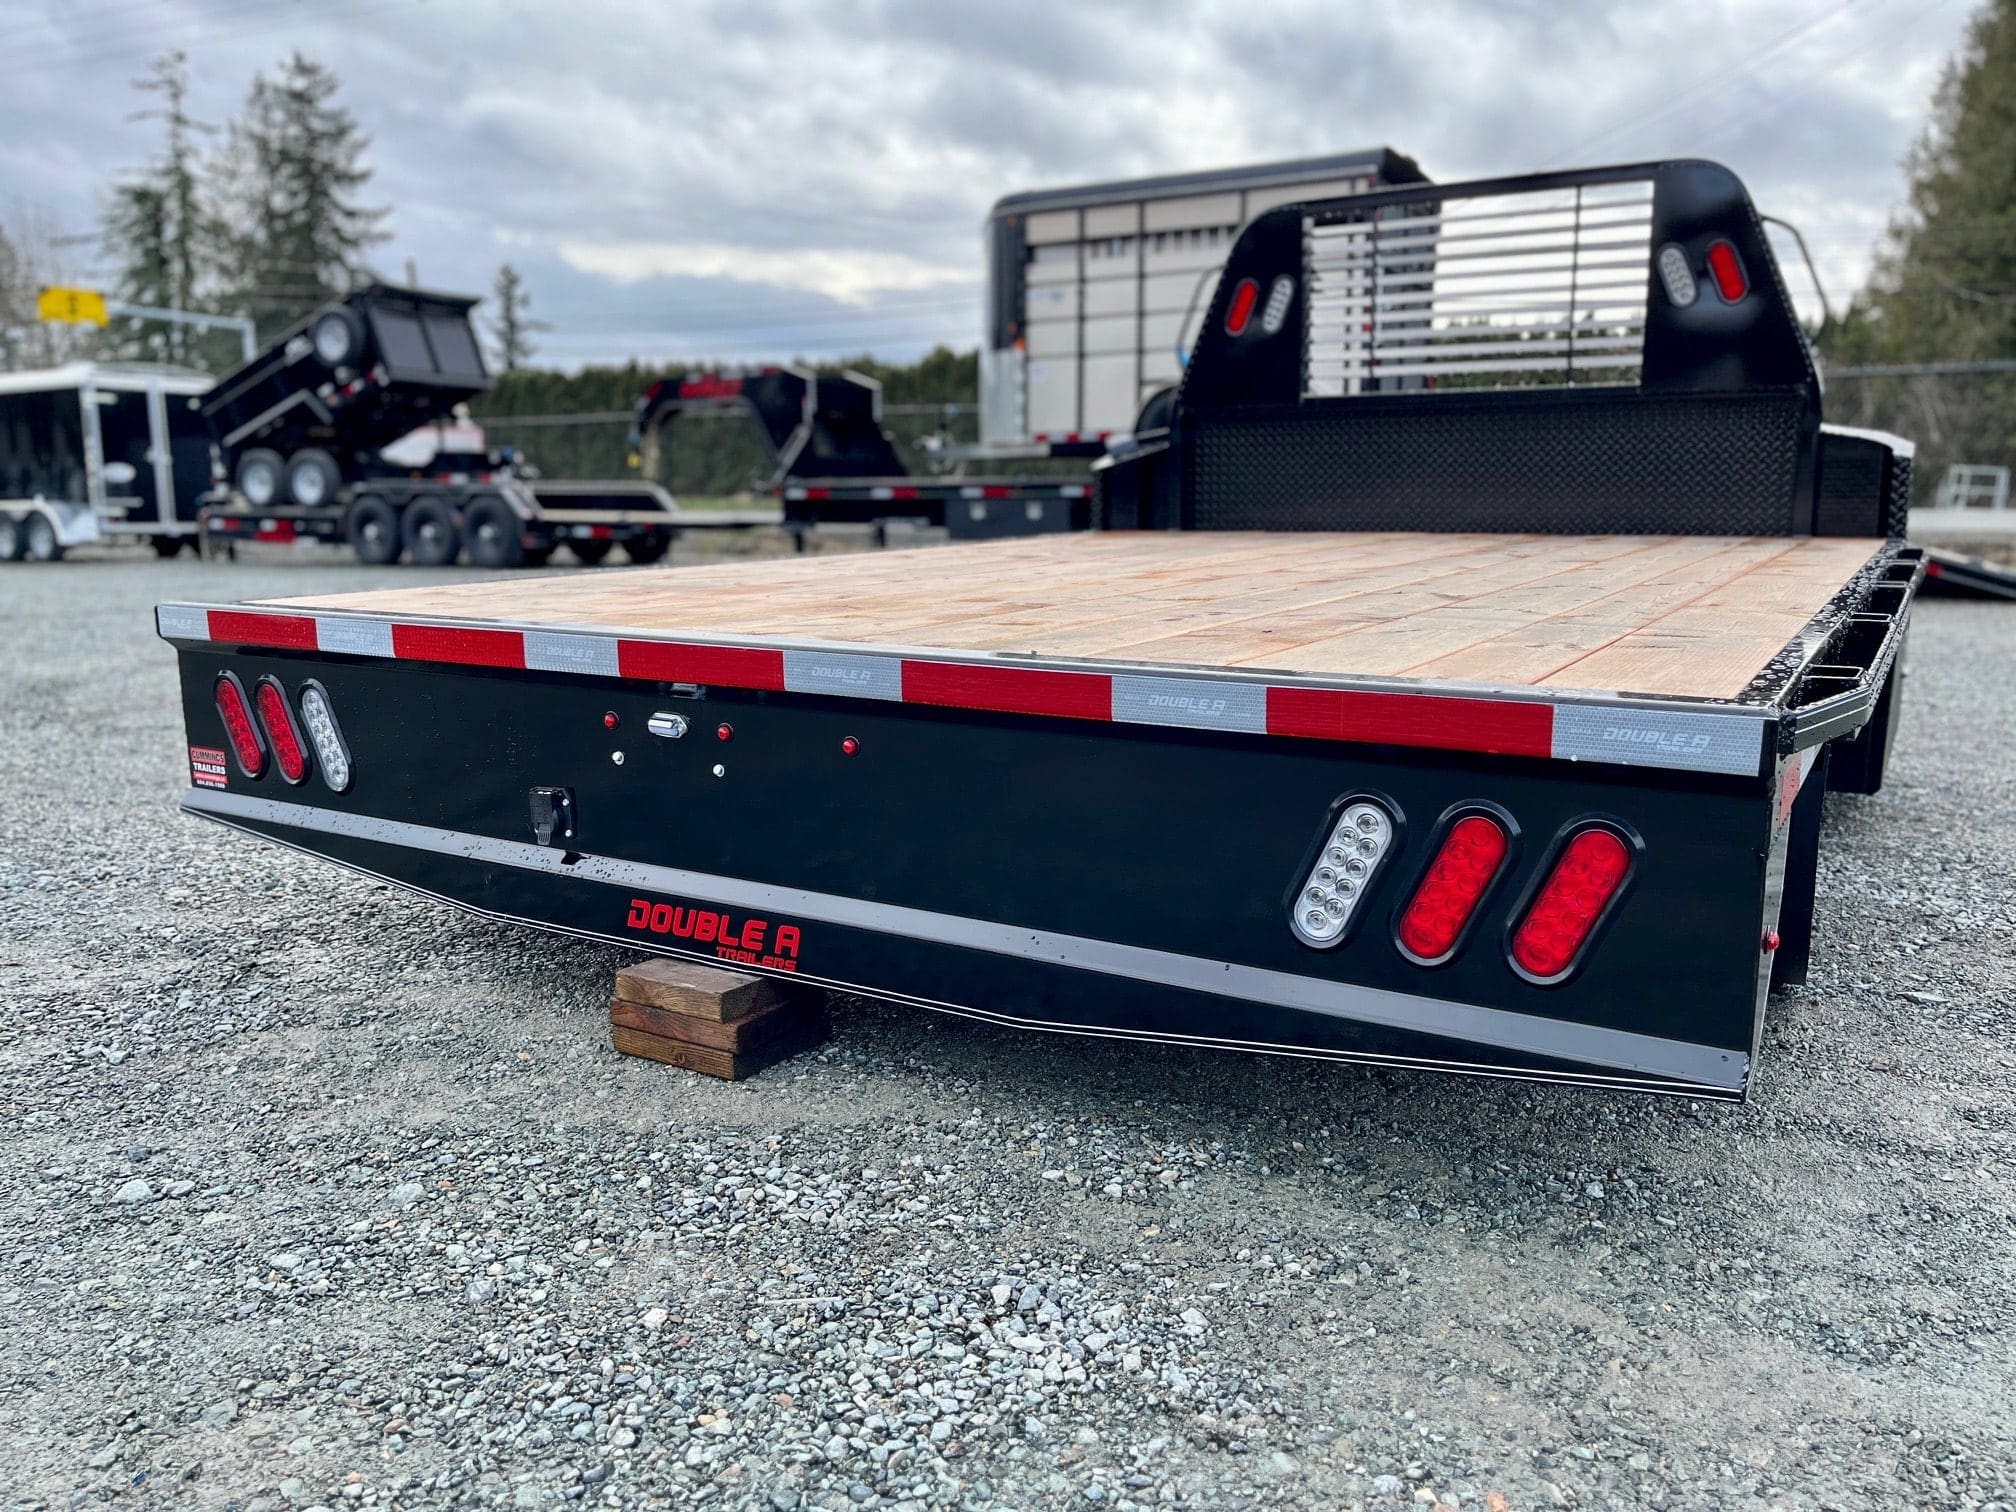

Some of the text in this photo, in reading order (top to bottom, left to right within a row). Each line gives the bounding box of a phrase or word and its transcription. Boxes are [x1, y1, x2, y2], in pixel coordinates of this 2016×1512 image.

[812, 666, 871, 681] DOUBLE A
[1150, 694, 1210, 708] DOUBLE
[1212, 700, 1226, 712] A
[1603, 727, 1689, 746] DOUBLE
[1691, 734, 1711, 748] A
[192, 750, 224, 763] CUMMINGS
[192, 762, 226, 775] TRAILERS
[627, 899, 800, 957] DOUBLE A
[716, 946, 797, 972] TRAILERS
